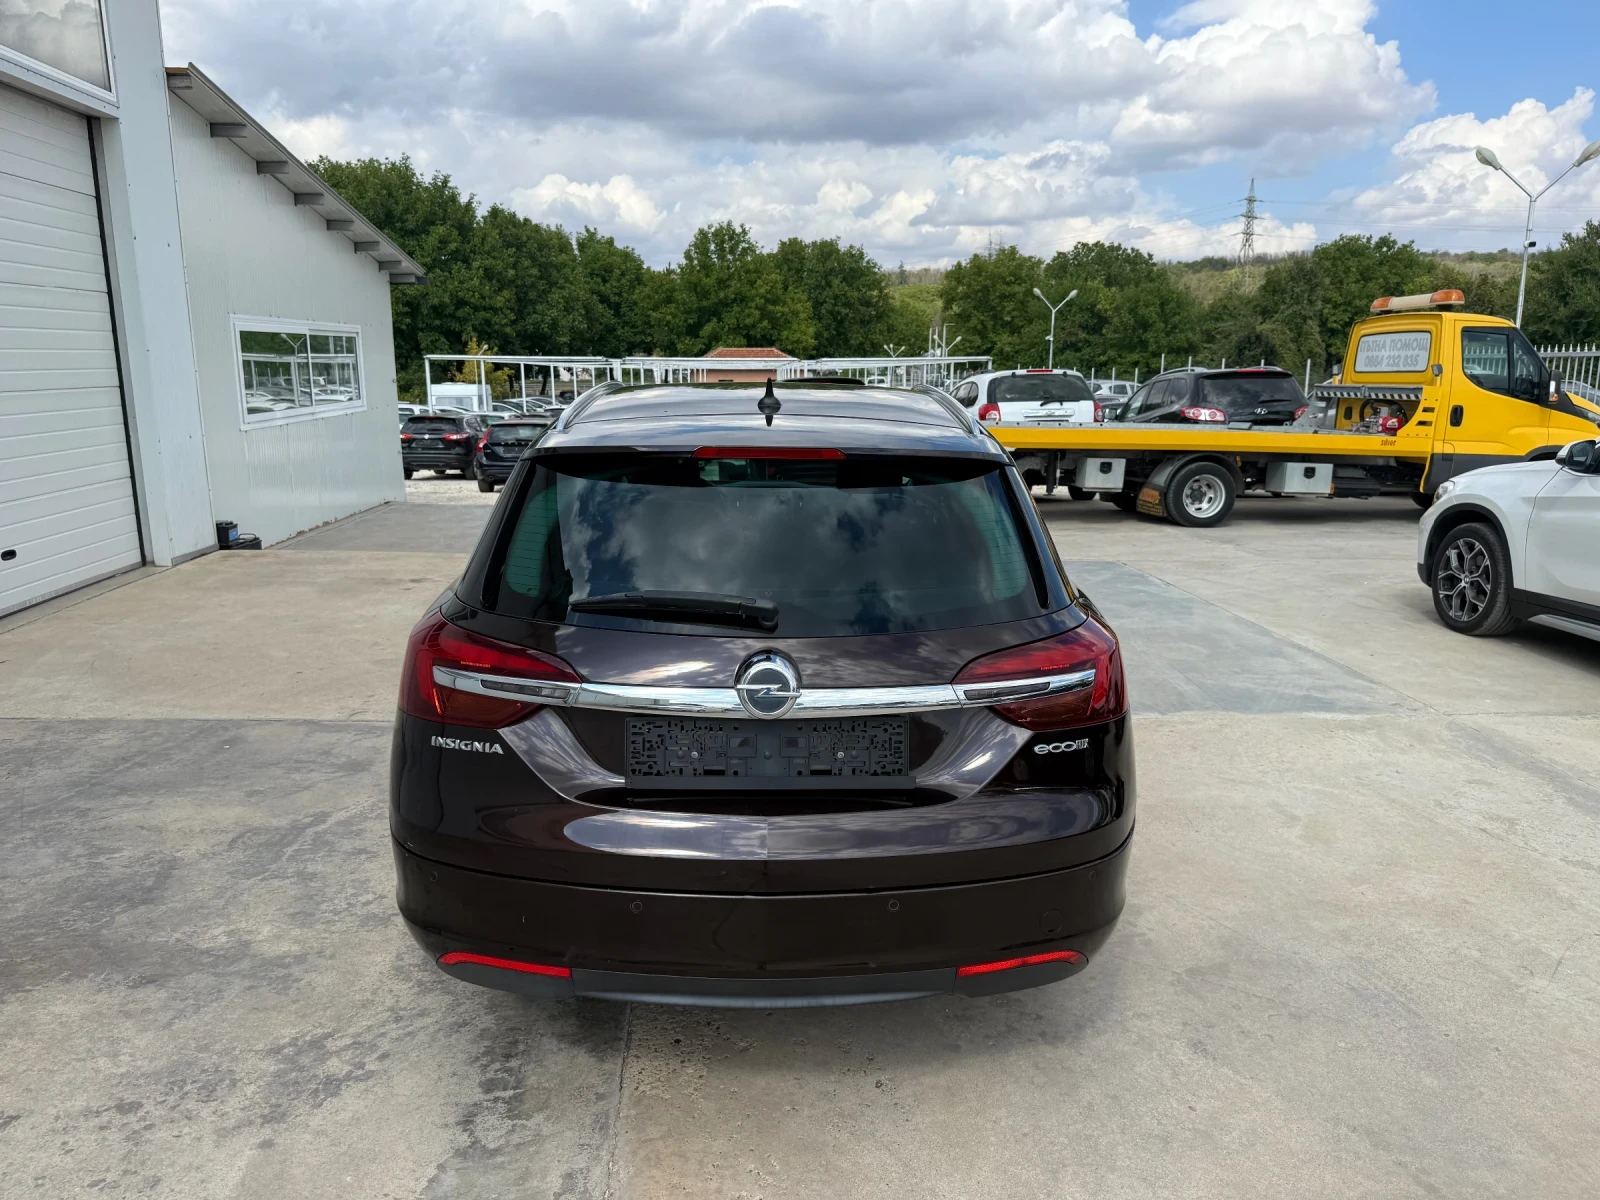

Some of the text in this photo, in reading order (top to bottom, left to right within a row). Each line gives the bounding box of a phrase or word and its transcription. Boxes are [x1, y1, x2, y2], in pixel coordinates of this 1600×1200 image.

[1360, 338, 1428, 352] ПЪТНА ПОМОЩ
[430, 735, 504, 754] INSIGNIA
